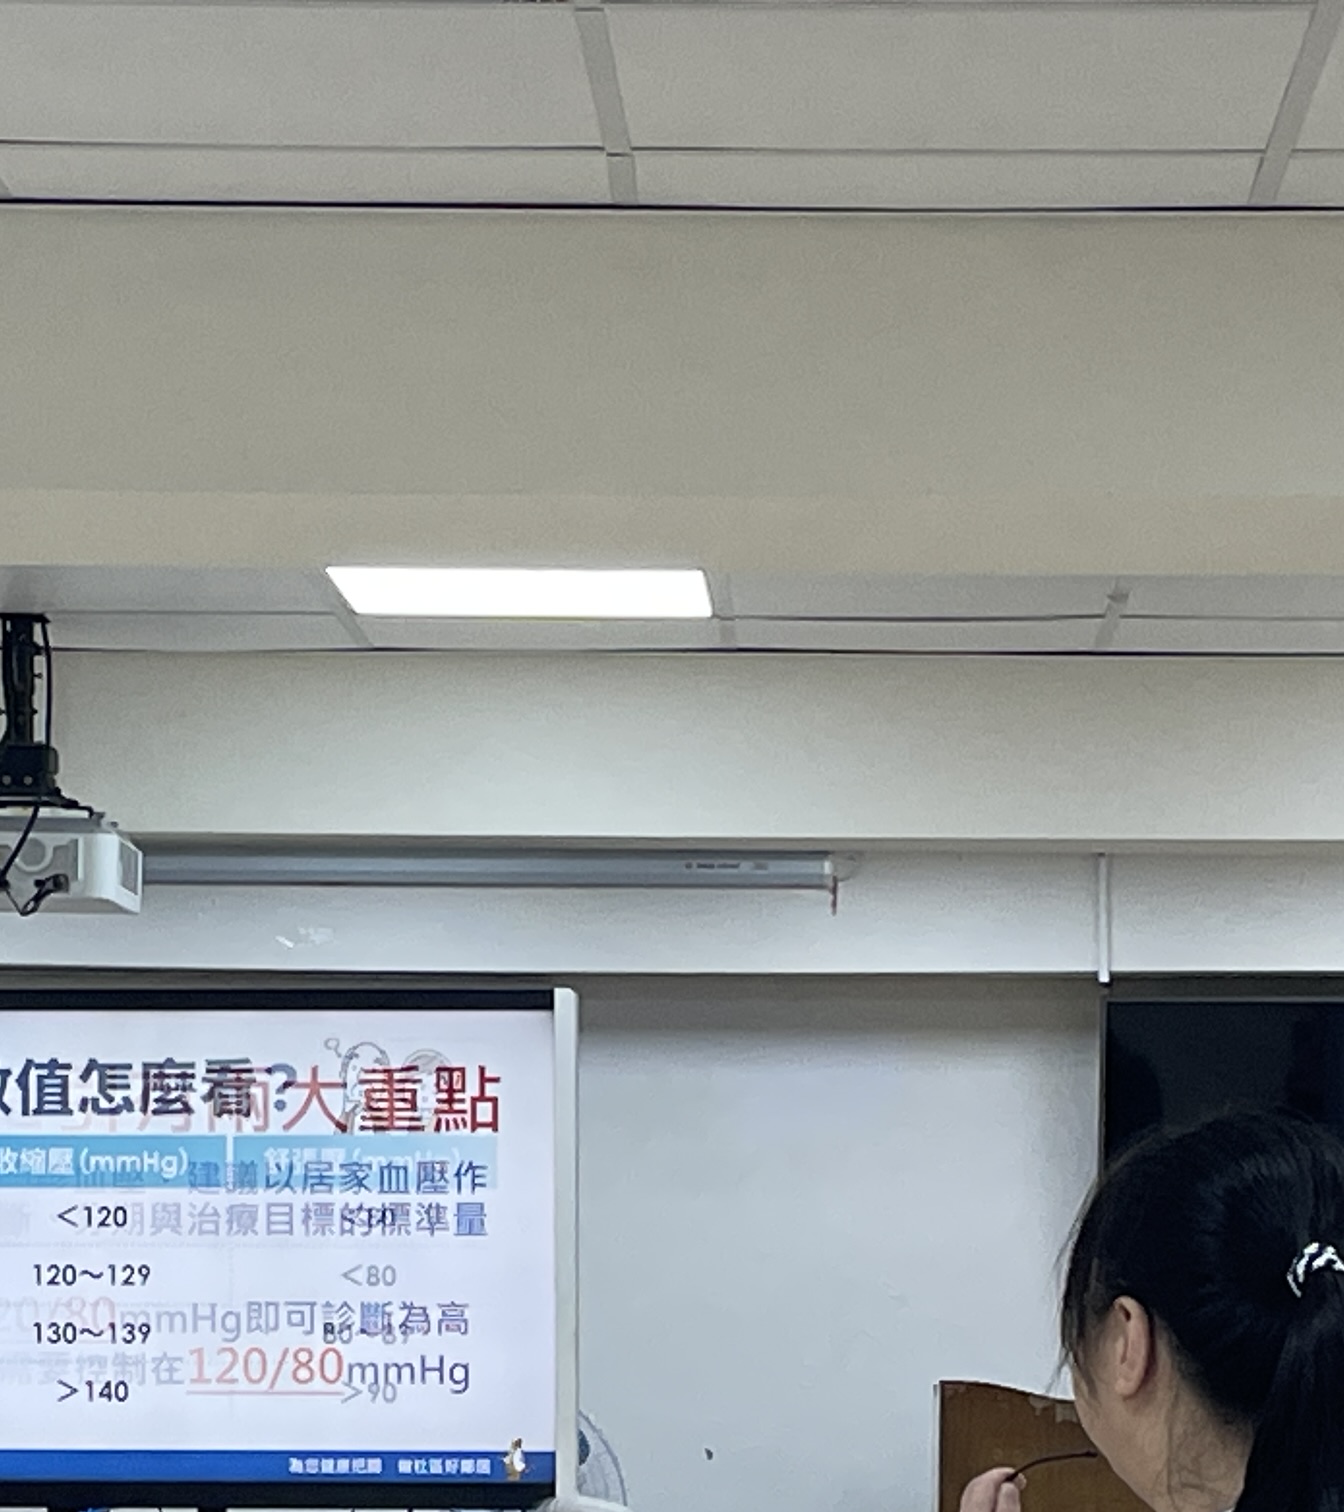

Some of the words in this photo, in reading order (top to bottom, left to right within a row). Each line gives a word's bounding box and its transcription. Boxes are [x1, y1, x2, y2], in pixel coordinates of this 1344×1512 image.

[57, 1204, 128, 1228] <120
[33, 1264, 151, 1286] 120～129
[33, 1322, 151, 1344] 130～139
[57, 1380, 129, 1402] >140
